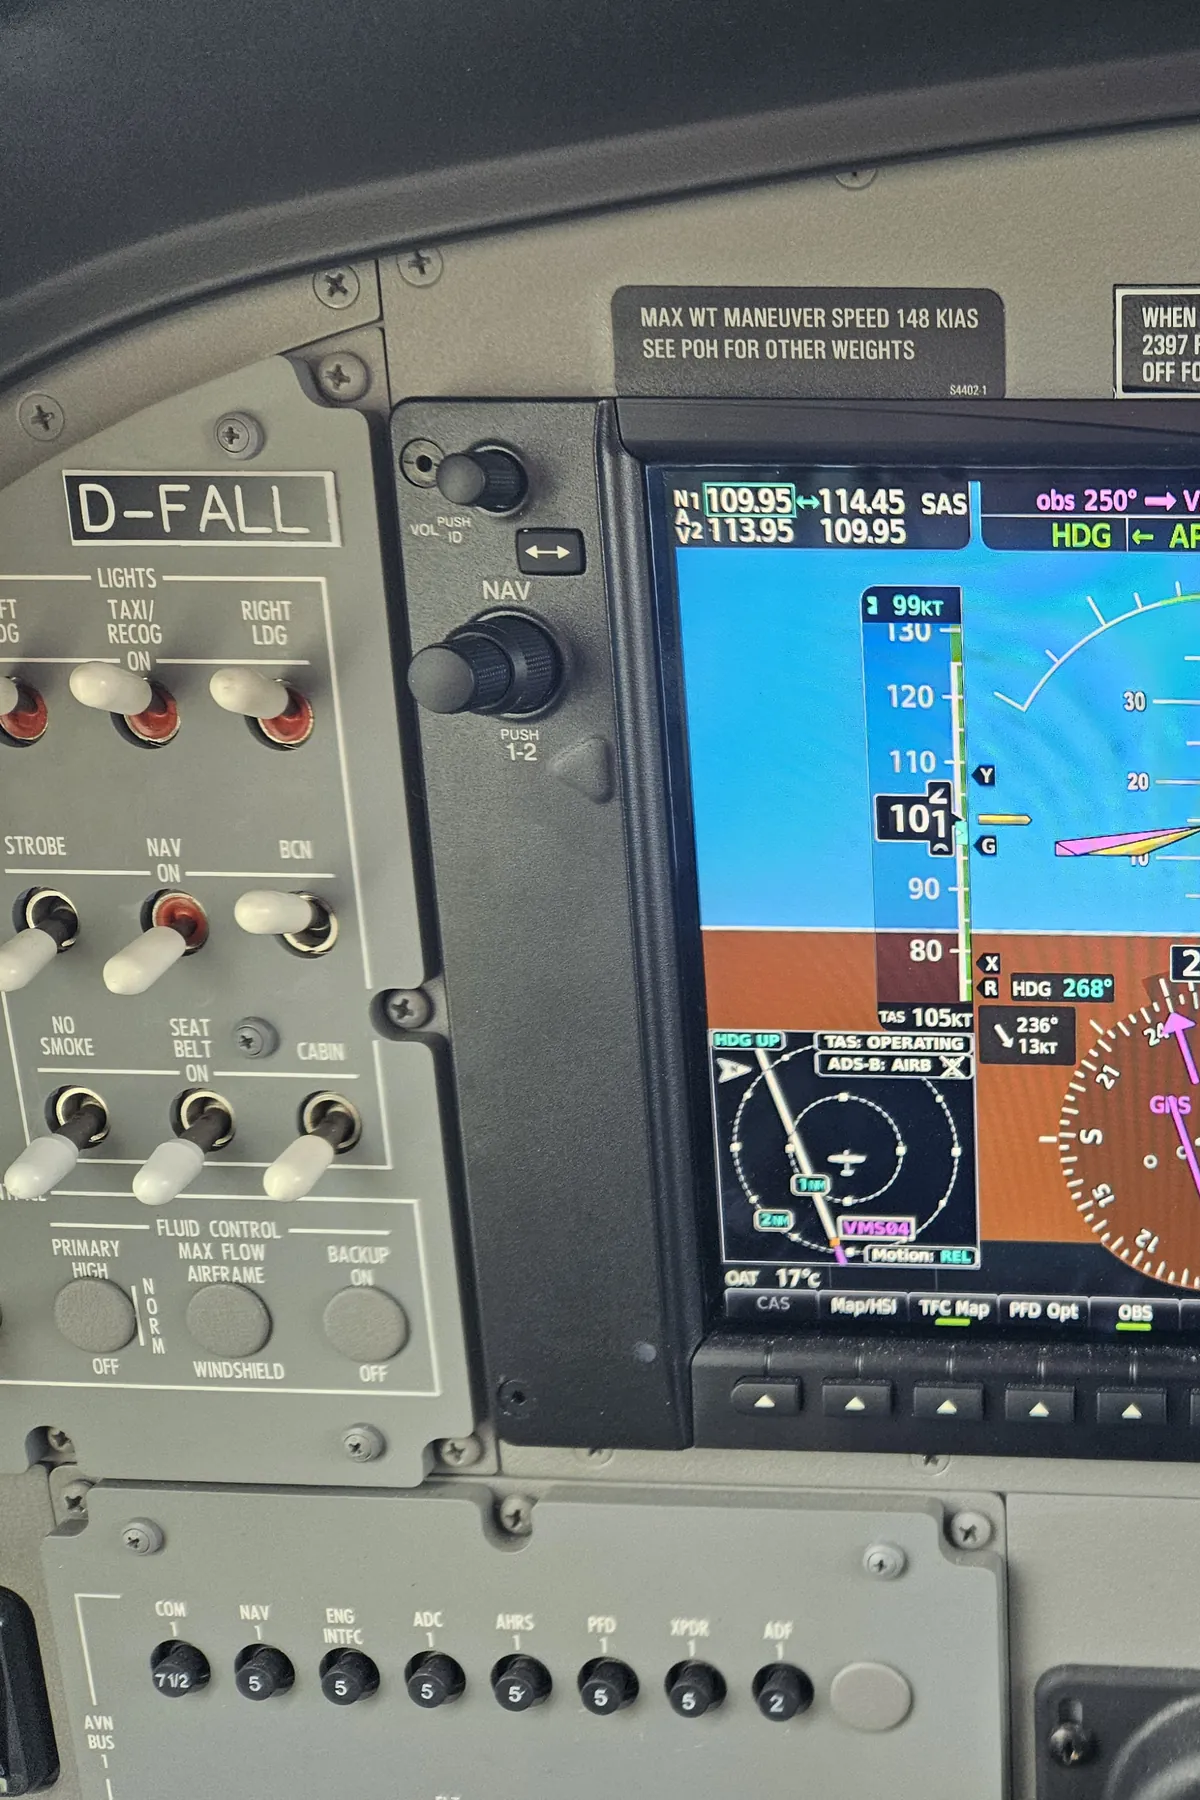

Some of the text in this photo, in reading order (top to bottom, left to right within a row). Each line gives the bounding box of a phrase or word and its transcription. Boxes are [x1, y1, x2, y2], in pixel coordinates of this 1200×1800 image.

[640, 307, 979, 329] MAX WT MANEUVER SPEED 148 KIAS
[1142, 307, 1197, 328] WHEN
[643, 339, 915, 360] SEE POH FOR OTHER WEIGHTS
[1142, 335, 1188, 356] 2397
[1142, 362, 1176, 383] OFF
[78, 484, 310, 533] D-FALL
[707, 487, 968, 516] 109.95 114.45 SAS
[1036, 489, 1075, 511] obs
[1083, 489, 1138, 512] 250°
[1052, 522, 1111, 548] HDG
[97, 567, 156, 588] LIGHTS
[482, 581, 530, 601] NAV
[107, 600, 154, 622] TAXI/
[241, 600, 291, 621] RIGHT
[107, 623, 162, 645] RECOG
[4, 836, 67, 856] STROBE
[146, 838, 182, 857] NAV
[52, 1015, 75, 1034] NO
[169, 1018, 211, 1037] SEAT
[40, 1037, 95, 1057] SMOKE
[173, 1040, 212, 1058] BELT
[296, 1041, 346, 1061] CABIN
[714, 1034, 780, 1048] HDG UP
[823, 1035, 964, 1051] TAS: OPERATING
[827, 1057, 932, 1073] ADS-B: AIRB
[156, 1219, 282, 1240] FLUID CONTROL
[52, 1239, 120, 1258] PRIMARY
[178, 1242, 266, 1262] MAX FLOW
[871, 1247, 972, 1263] Motion: REL
[187, 1265, 265, 1284] AIRFRAME
[1009, 1301, 1079, 1323] PFD Opt
[193, 1361, 285, 1380] WINDSHIELD
[156, 1601, 186, 1618] COM
[240, 1605, 269, 1621] NAV
[413, 1612, 443, 1627] ADC
[496, 1614, 534, 1630] AHRS
